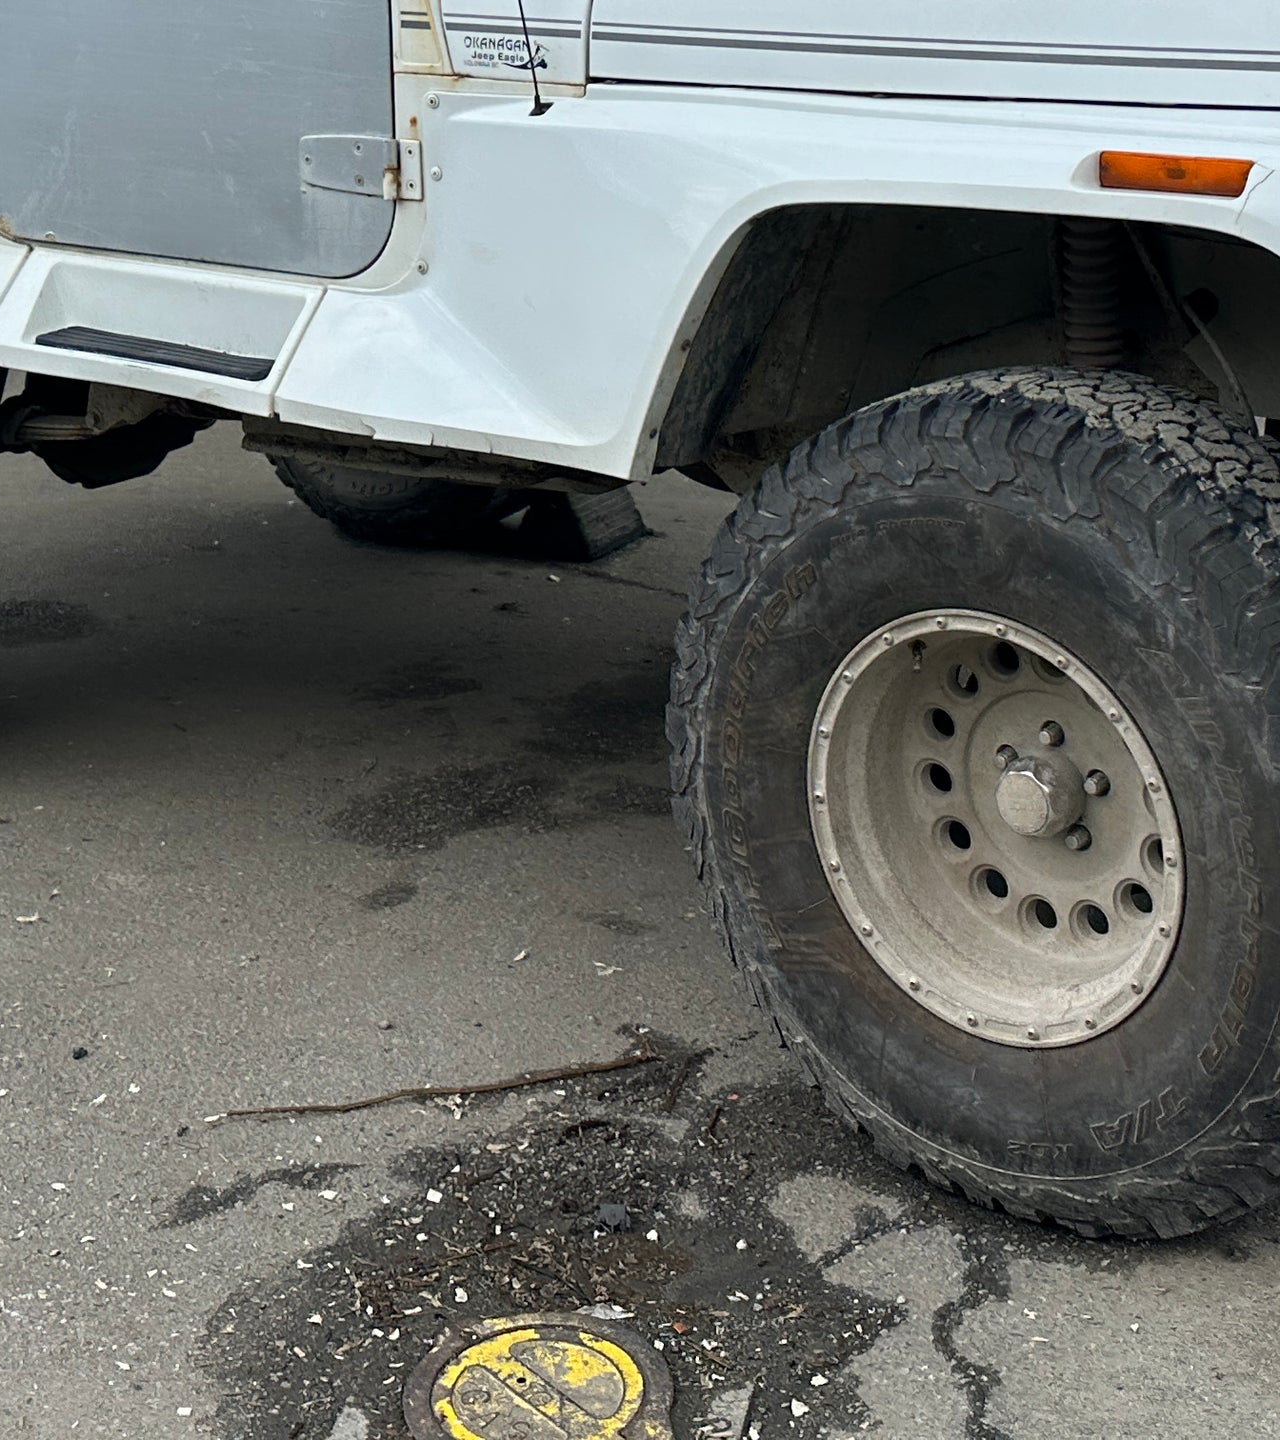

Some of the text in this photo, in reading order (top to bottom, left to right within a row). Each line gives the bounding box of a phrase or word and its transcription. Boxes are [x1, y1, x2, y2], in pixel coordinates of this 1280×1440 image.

[463, 35, 531, 53] OKANAGAN
[471, 50, 495, 62] Jeep
[497, 51, 525, 64] Eagle
